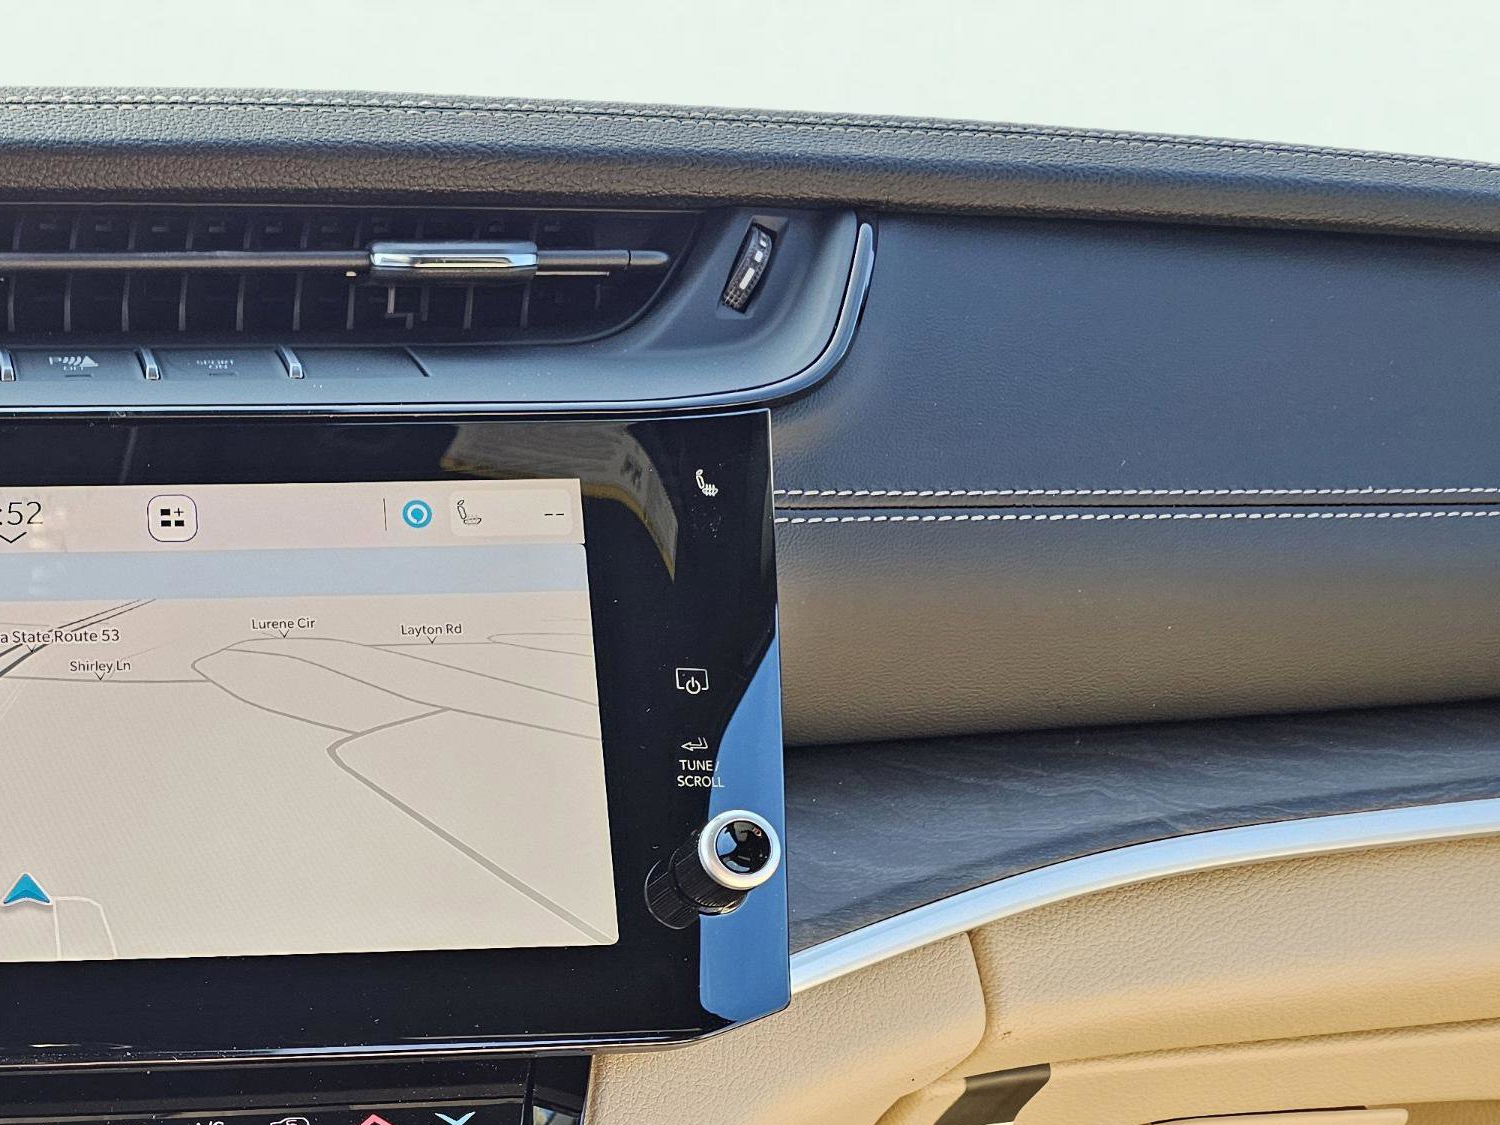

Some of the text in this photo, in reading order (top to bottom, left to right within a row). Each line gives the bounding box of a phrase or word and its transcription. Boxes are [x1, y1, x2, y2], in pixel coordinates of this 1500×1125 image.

[252, 618, 315, 629] Lurene Cir
[401, 624, 462, 636] Layton Rd
[13, 631, 50, 643] State
[55, 631, 97, 642] Route
[102, 629, 120, 641] 53
[70, 661, 131, 674] Shirley Ln
[677, 775, 724, 788] SCROLL
